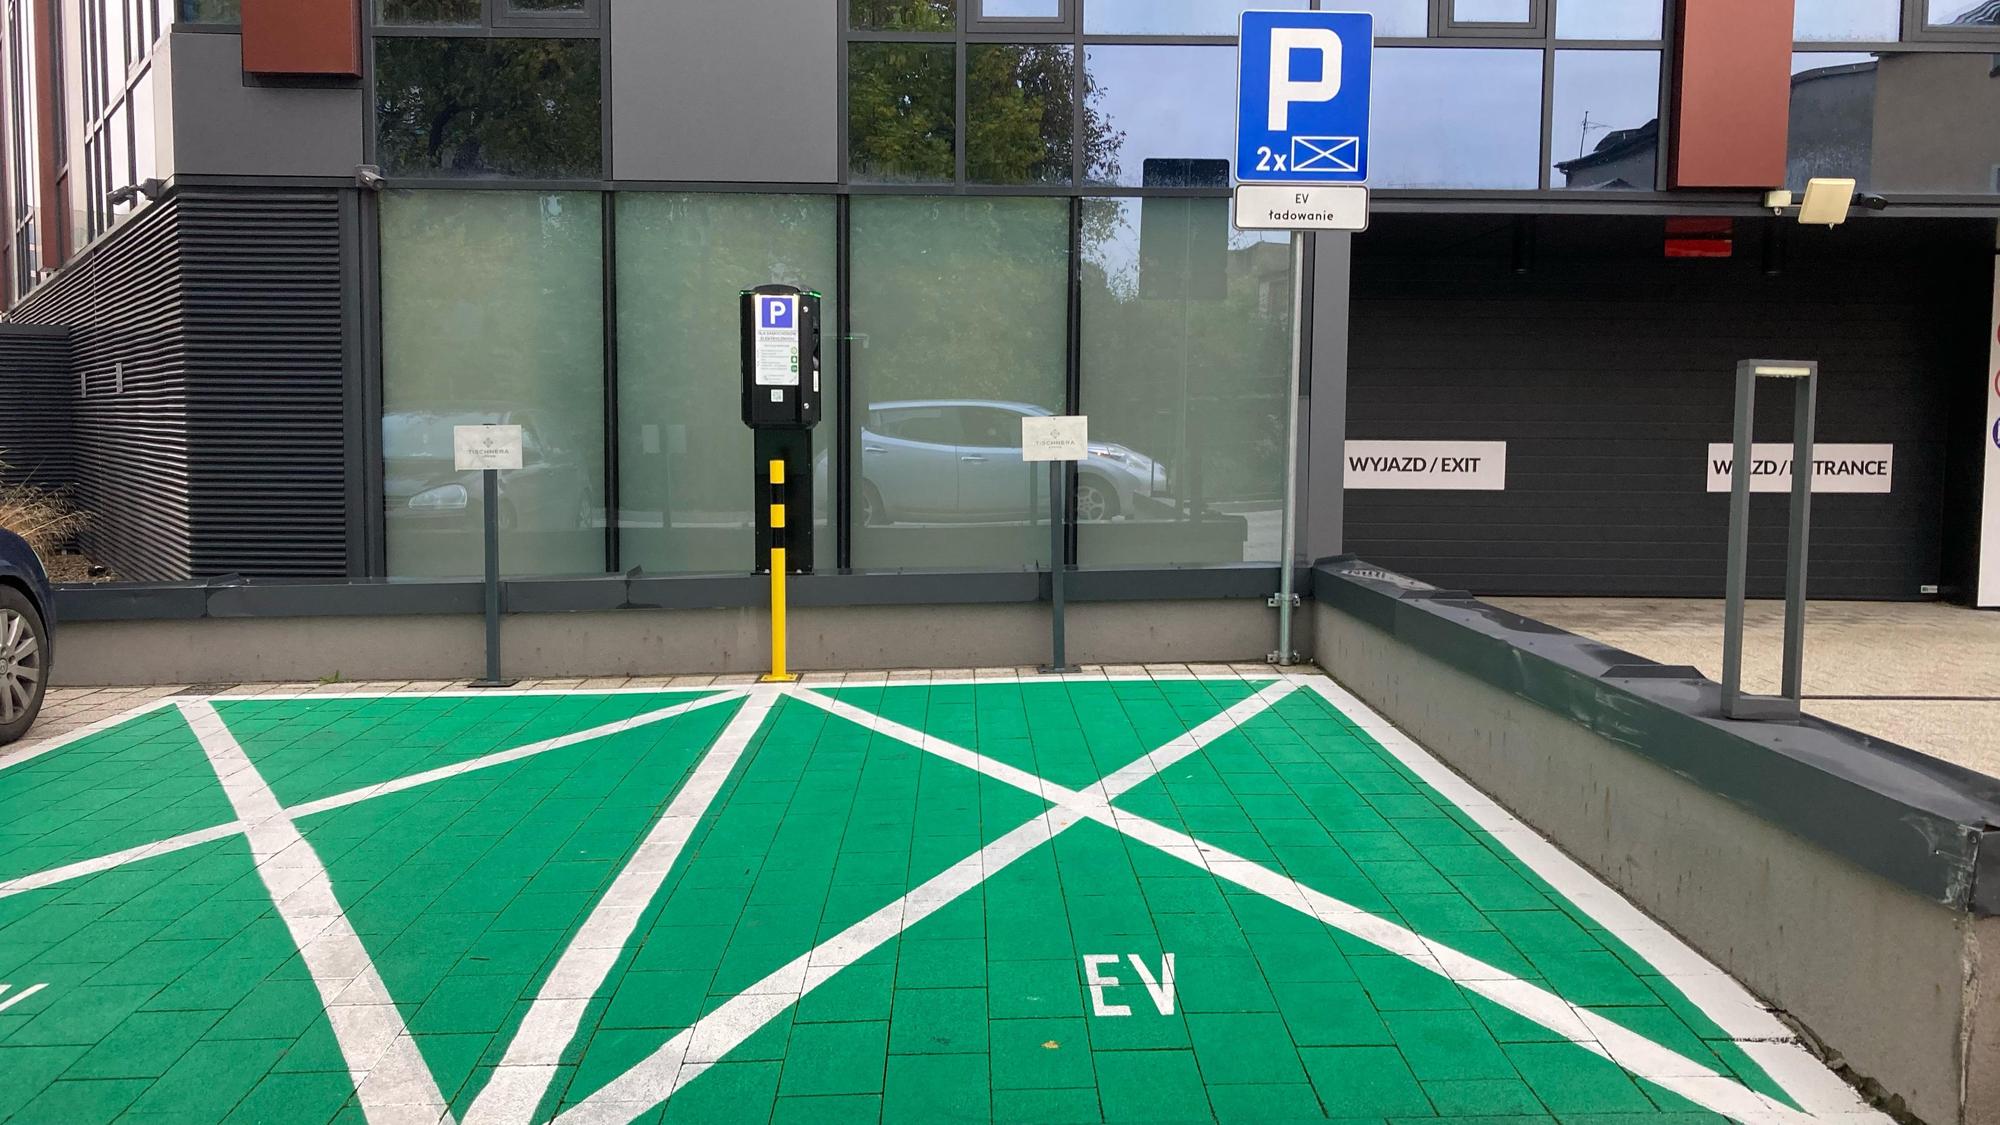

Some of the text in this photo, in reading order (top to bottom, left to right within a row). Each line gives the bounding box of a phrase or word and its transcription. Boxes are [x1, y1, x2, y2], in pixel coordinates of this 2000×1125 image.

[1268, 28, 1343, 131] P
[1256, 146, 1288, 171] 2x
[1295, 193, 1309, 204] EV
[1269, 210, 1334, 221] ładowanie
[770, 301, 786, 325] P
[1349, 457, 1427, 472] WYJAZD
[1441, 457, 1481, 473] EXIT
[1713, 460, 1777, 475] WZD
[1790, 460, 1887, 475] TRANCE
[1083, 953, 1175, 1016] EV
